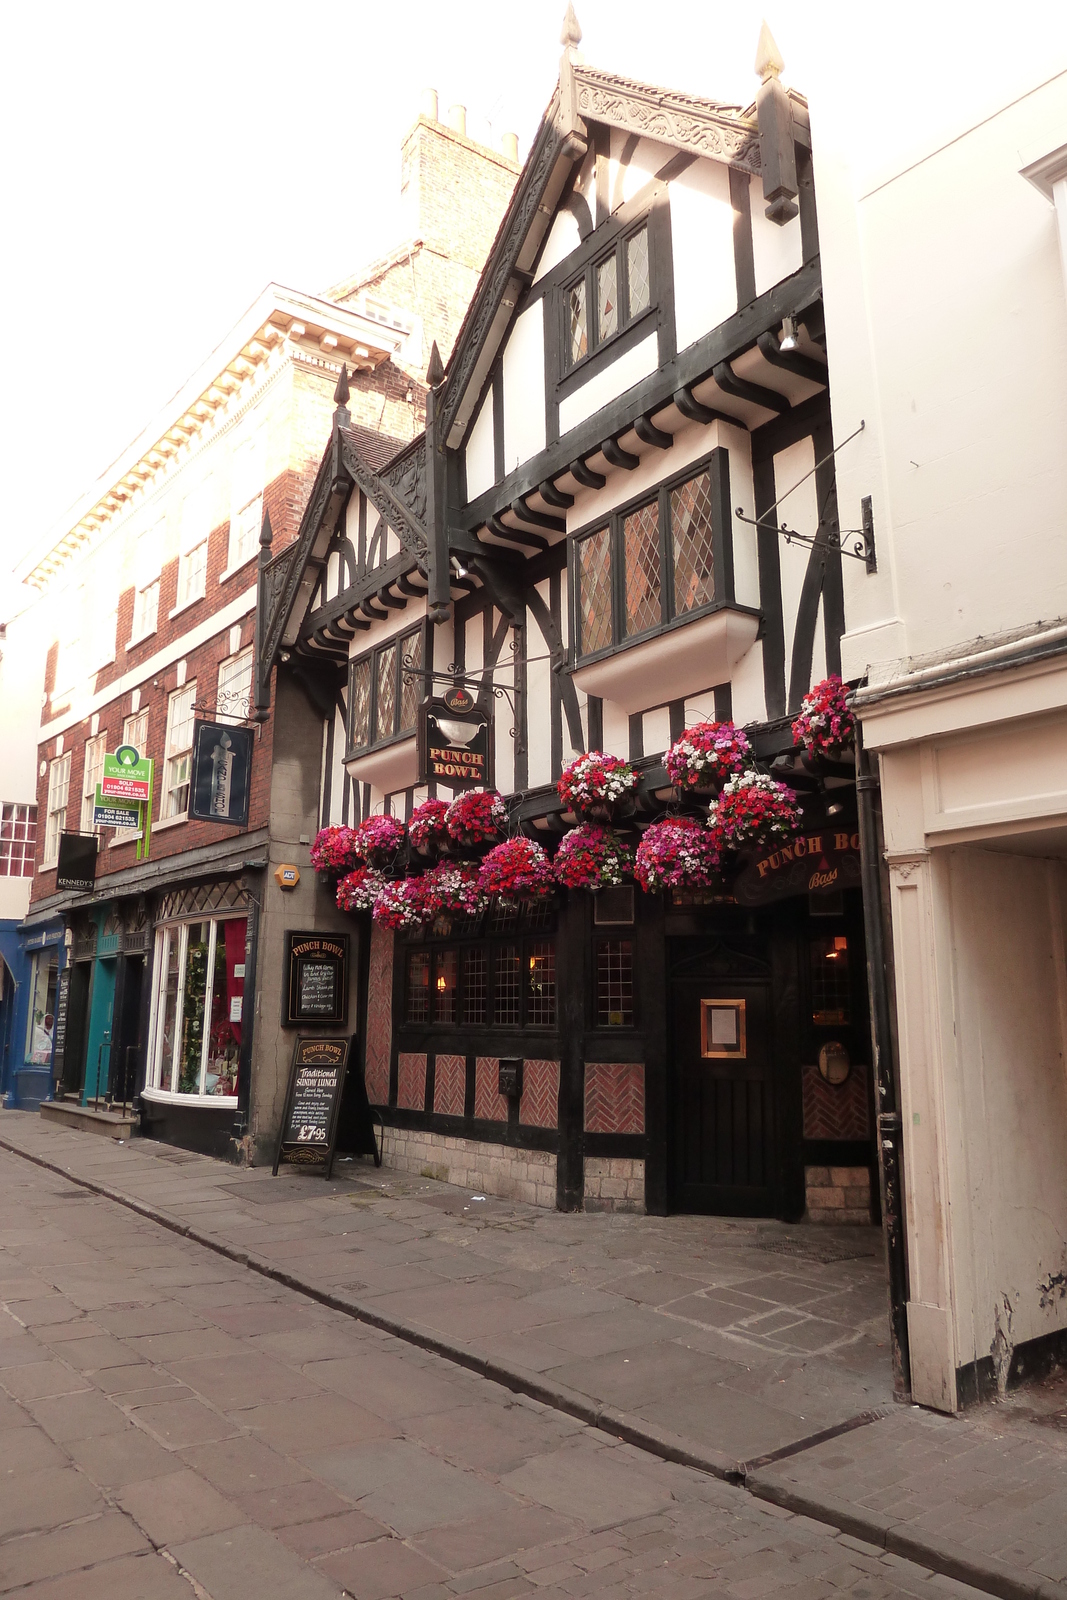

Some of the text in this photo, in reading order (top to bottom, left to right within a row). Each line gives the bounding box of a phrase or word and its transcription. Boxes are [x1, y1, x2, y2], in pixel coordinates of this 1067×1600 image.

[450, 698, 469, 707] Bass
[429, 748, 484, 766] PUNCH
[108, 766, 126, 774] YOUR
[433, 762, 482, 780] BOWL
[104, 789, 146, 797] your-move.co.uk
[756, 832, 860, 878] PUNCH BO
[808, 867, 838, 890] Bass
[292, 941, 344, 957] PUNCH BOWL
[303, 964, 314, 972] Why
[302, 1044, 342, 1056] PUNCH BOWL
[300, 1067, 336, 1078] Traditional
[296, 1078, 337, 1087] SUNDAY LUNCH
